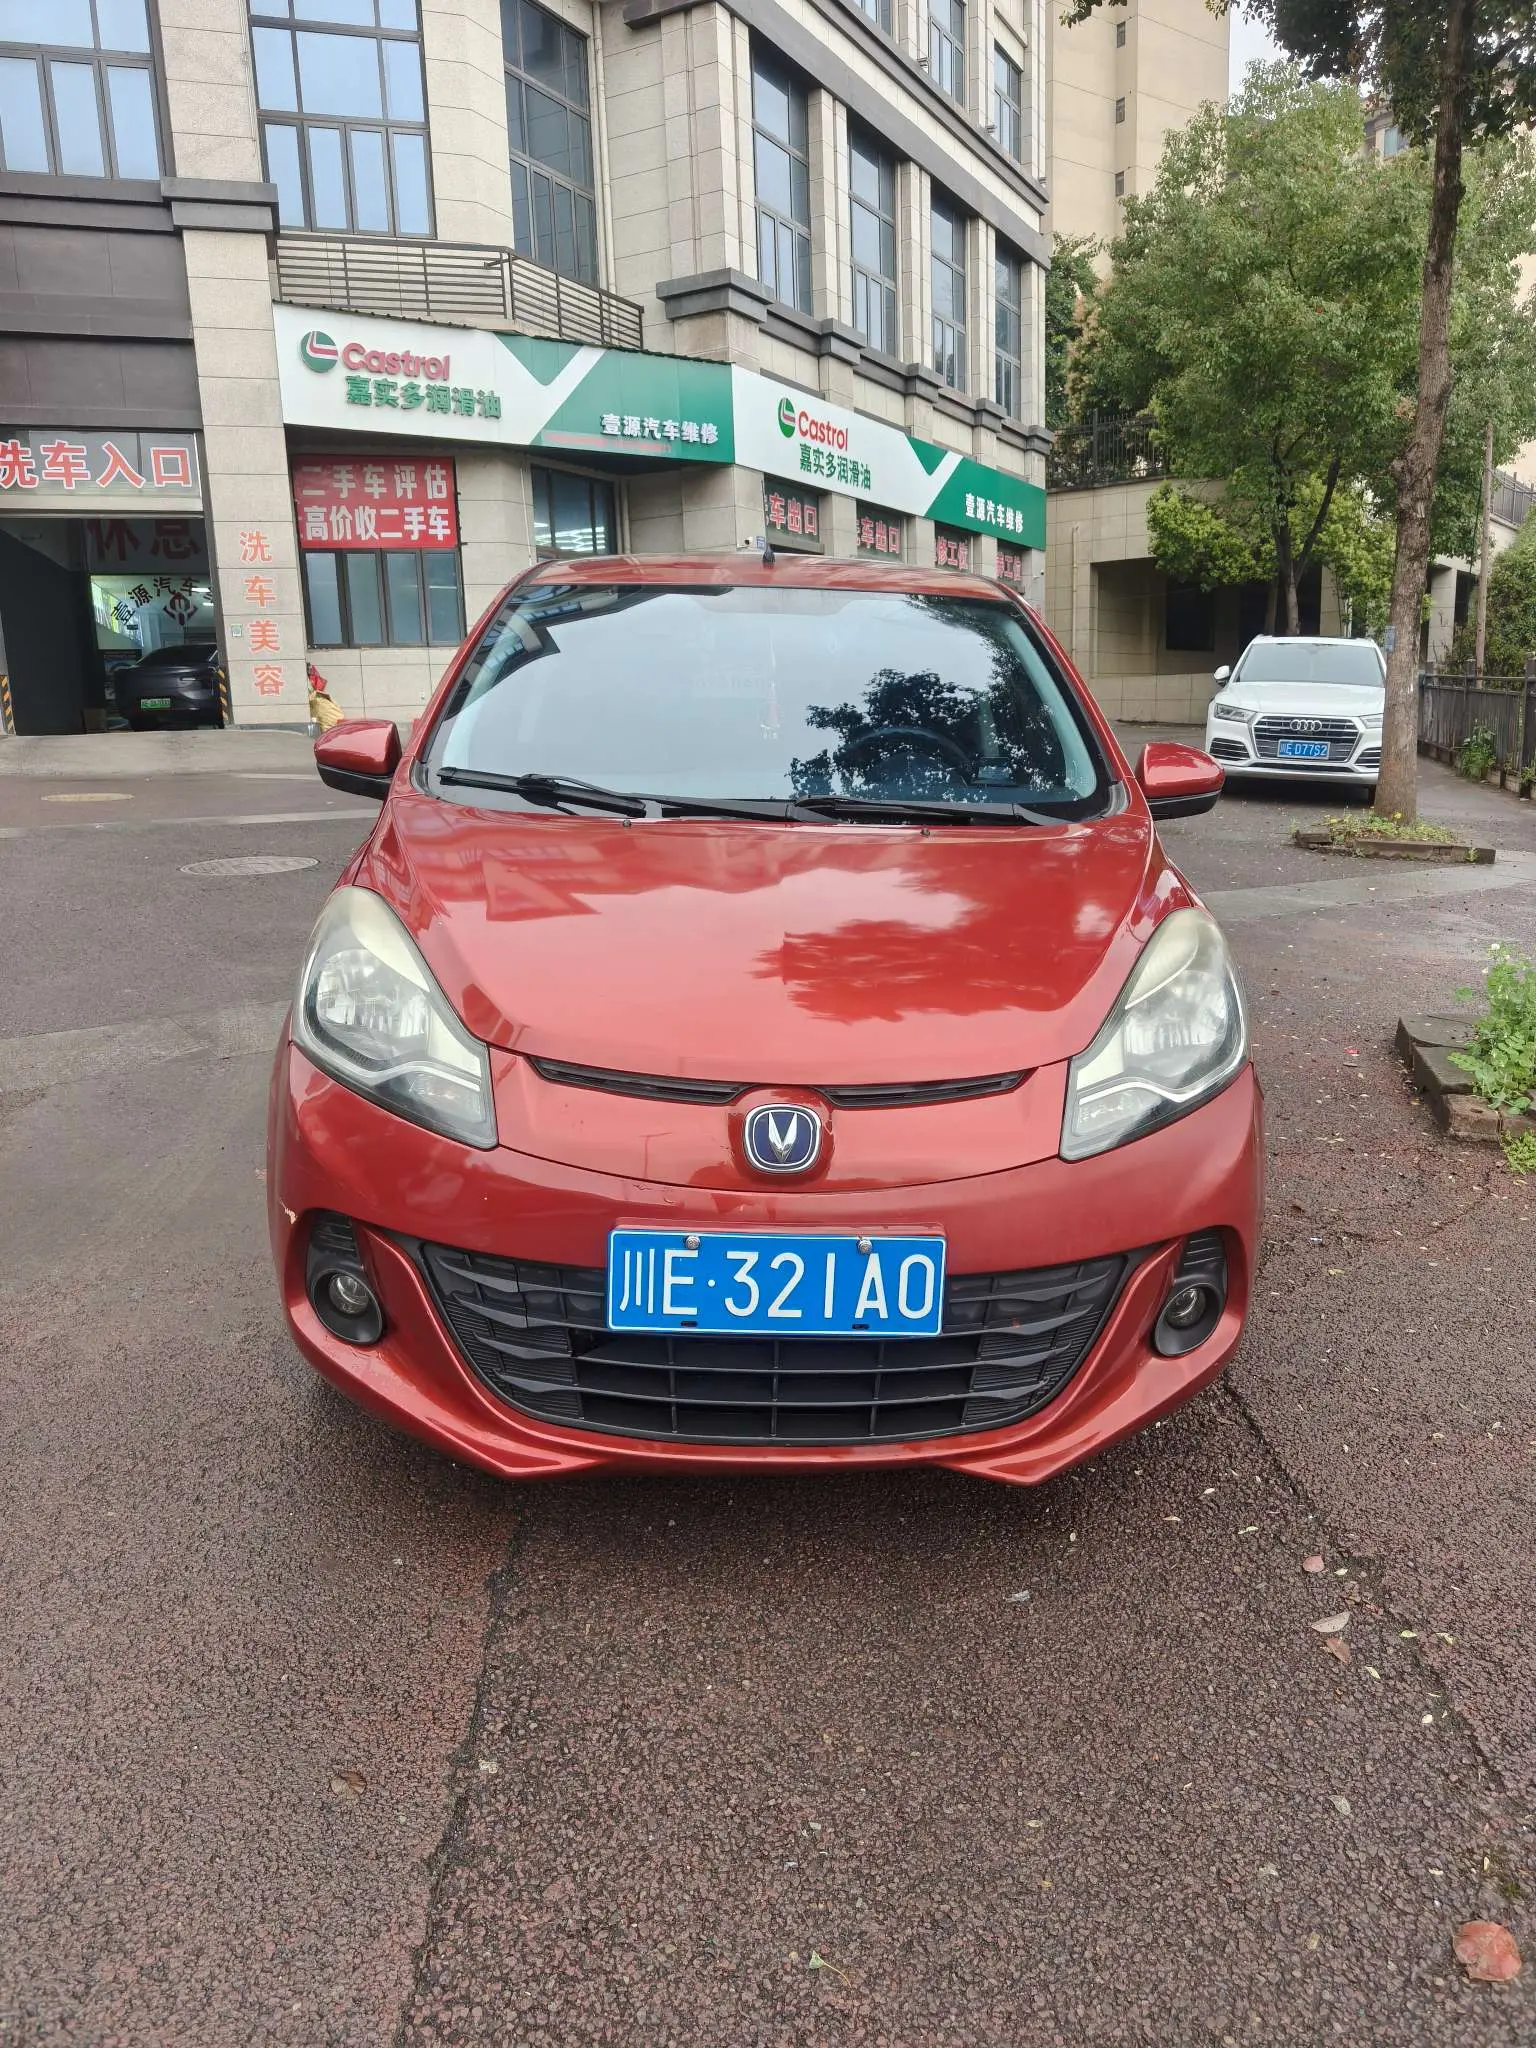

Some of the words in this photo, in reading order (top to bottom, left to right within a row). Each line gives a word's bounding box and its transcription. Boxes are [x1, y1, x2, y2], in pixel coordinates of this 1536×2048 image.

[341, 342, 450, 381] Castrol
[345, 375, 502, 419] 嘉实多润滑油
[600, 413, 719, 444] 壹源汽车维修
[798, 411, 849, 451] Castrol
[0, 439, 192, 489] 洗车入口
[302, 464, 448, 499] 二手车评估
[800, 443, 871, 490] 嘉实多润滑油
[303, 505, 451, 541] 高价收二手车
[965, 493, 1023, 533] 壹源汽车维修
[239, 529, 285, 697] 洗车美容
